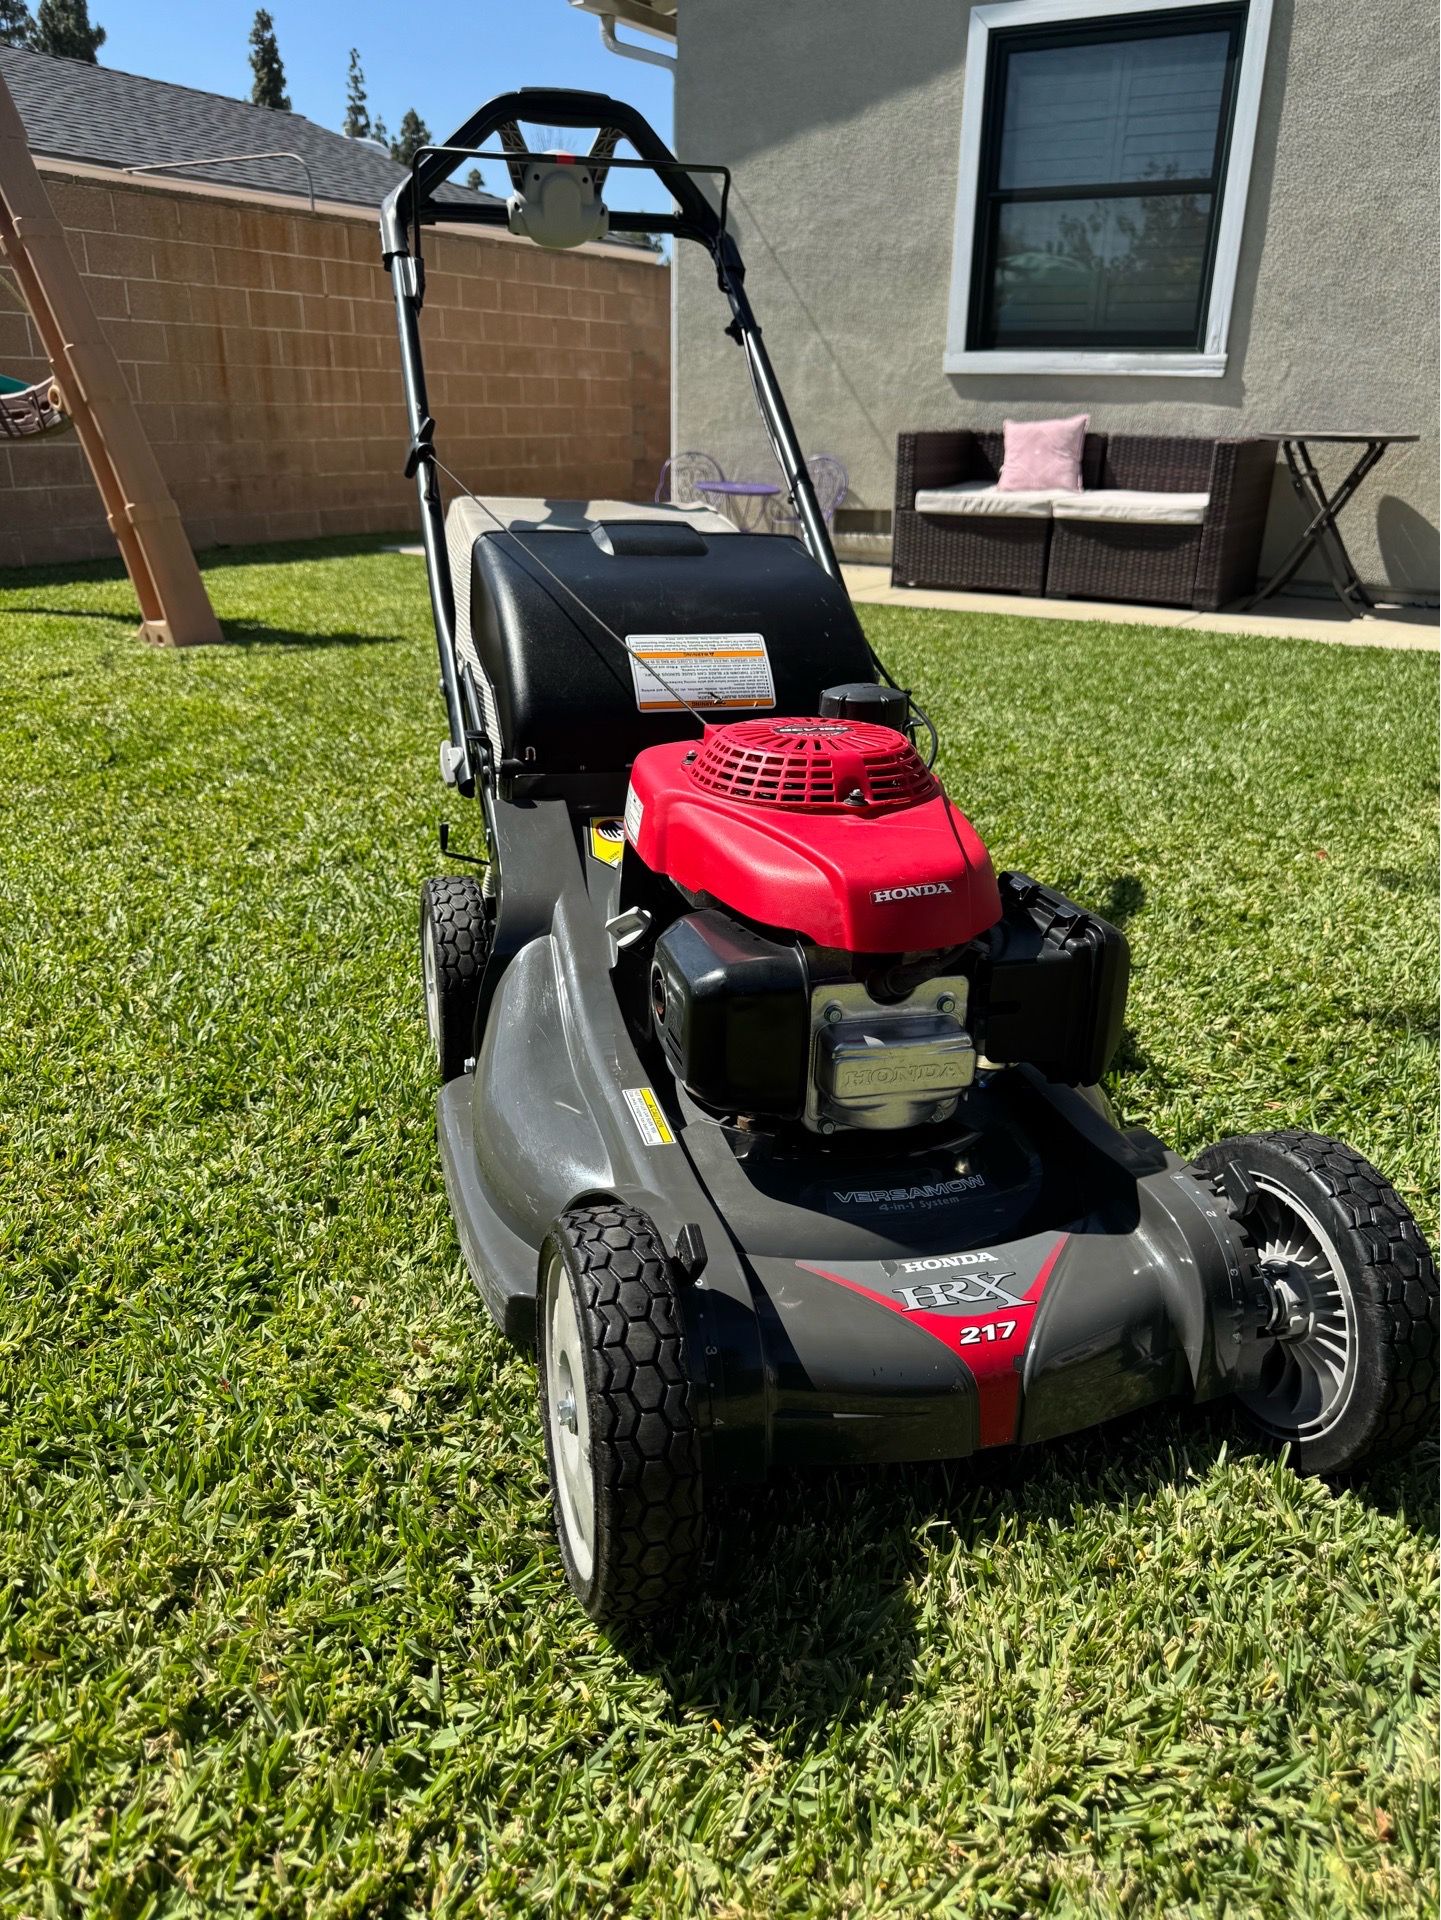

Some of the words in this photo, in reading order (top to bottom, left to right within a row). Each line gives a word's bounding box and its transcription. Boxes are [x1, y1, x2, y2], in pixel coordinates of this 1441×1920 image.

[873, 882, 952, 903] HONDA
[845, 1062, 966, 1087] HONDA
[833, 1174, 986, 1203] VERSAMOW
[878, 1201, 915, 1212] 4-in-1
[919, 1195, 960, 1210] System
[1206, 1209, 1218, 1218] 2
[902, 1251, 999, 1273] HONDA
[1229, 1267, 1240, 1277] 3
[892, 1271, 1038, 1312] HRX
[959, 1320, 1018, 1346] 217
[705, 1345, 718, 1355] 3
[713, 1417, 725, 1427] 4
